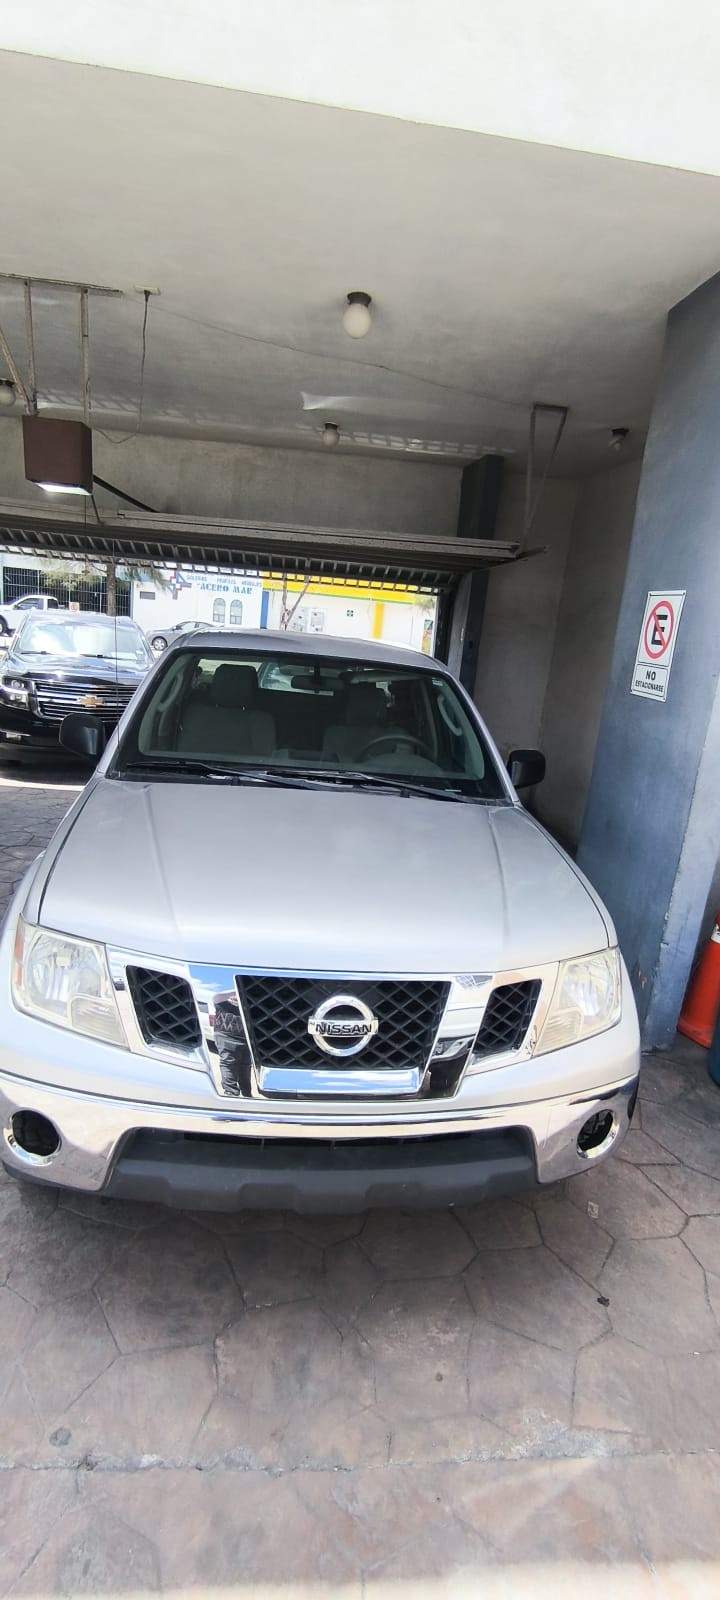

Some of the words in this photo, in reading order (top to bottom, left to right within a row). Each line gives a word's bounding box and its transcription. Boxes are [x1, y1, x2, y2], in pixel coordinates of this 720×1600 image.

[645, 669, 657, 681] NO
[634, 680, 664, 693] ESTACIONARSE
[315, 1023, 372, 1034] NISSAN
